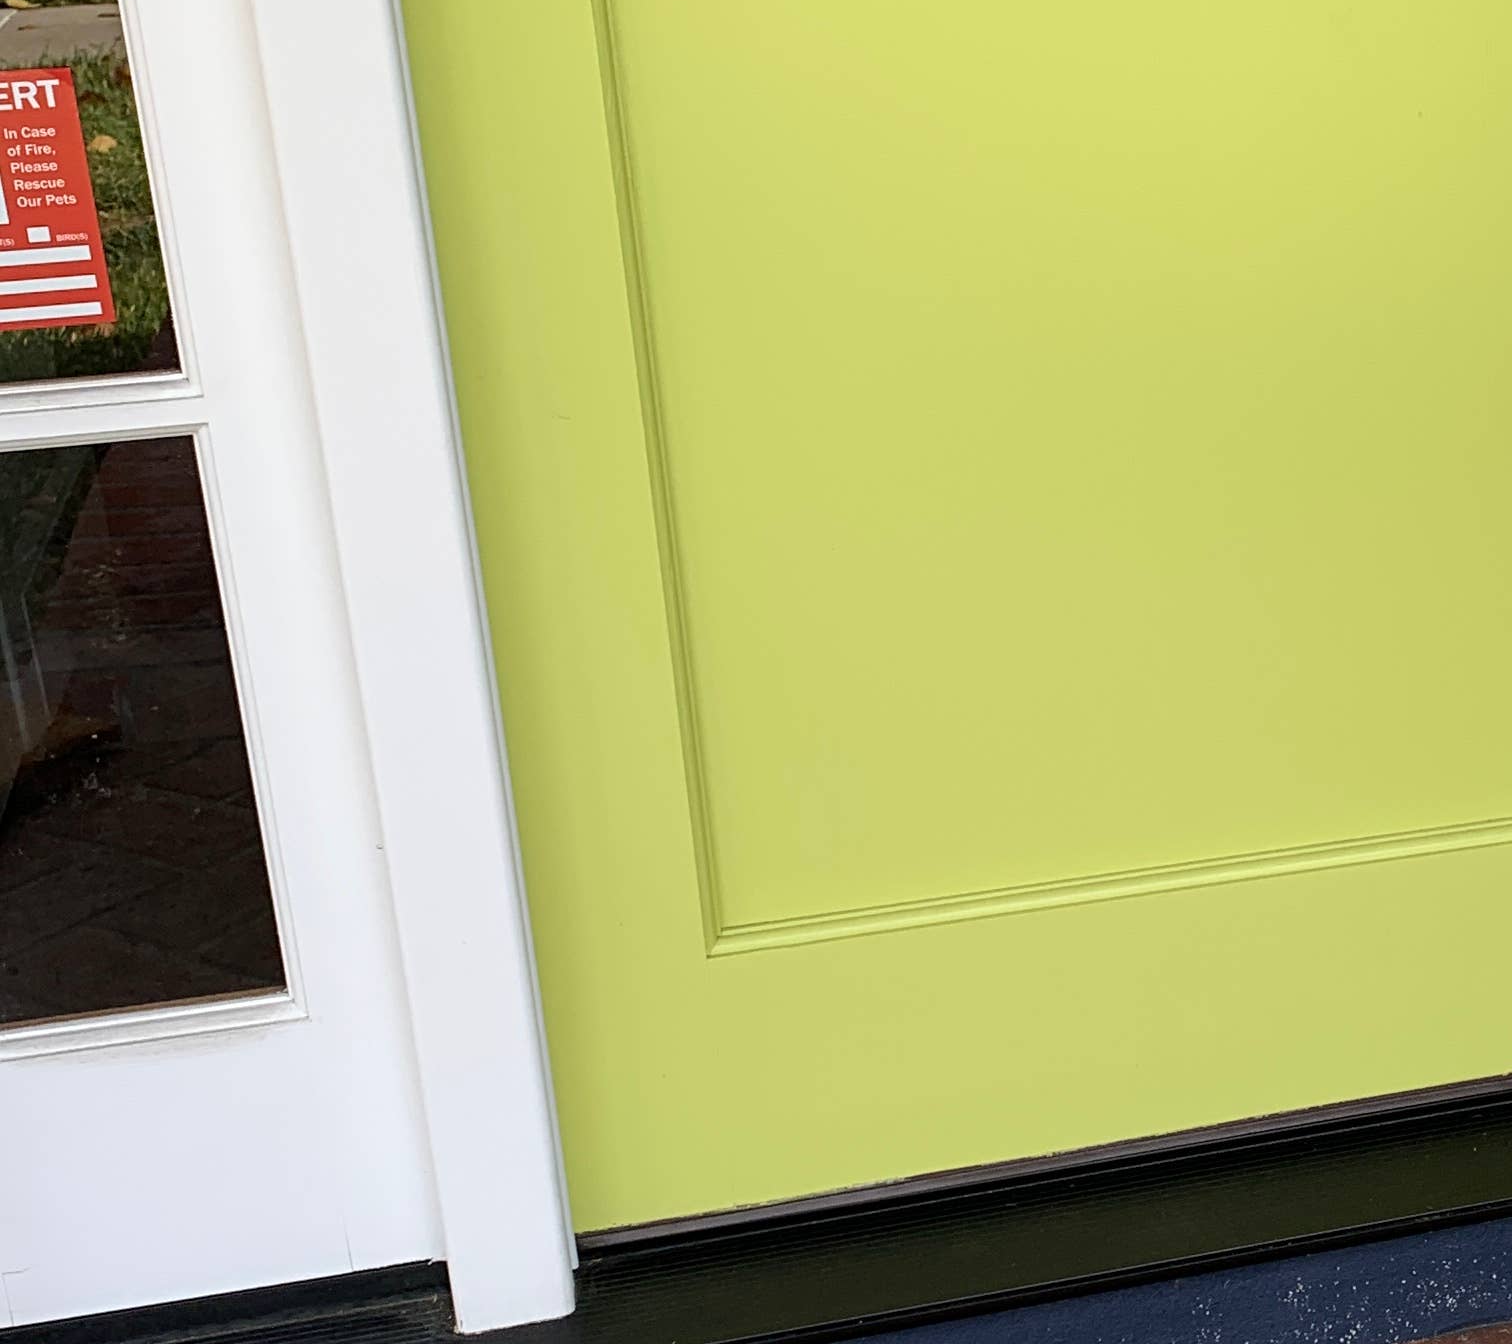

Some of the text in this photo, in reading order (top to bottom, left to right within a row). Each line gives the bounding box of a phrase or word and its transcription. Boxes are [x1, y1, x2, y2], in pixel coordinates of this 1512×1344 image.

[4, 126, 56, 139] In Case
[7, 143, 56, 157] of Fire,
[10, 161, 58, 174] Please
[14, 178, 65, 191] Rescue
[17, 194, 77, 207] Our Pets
